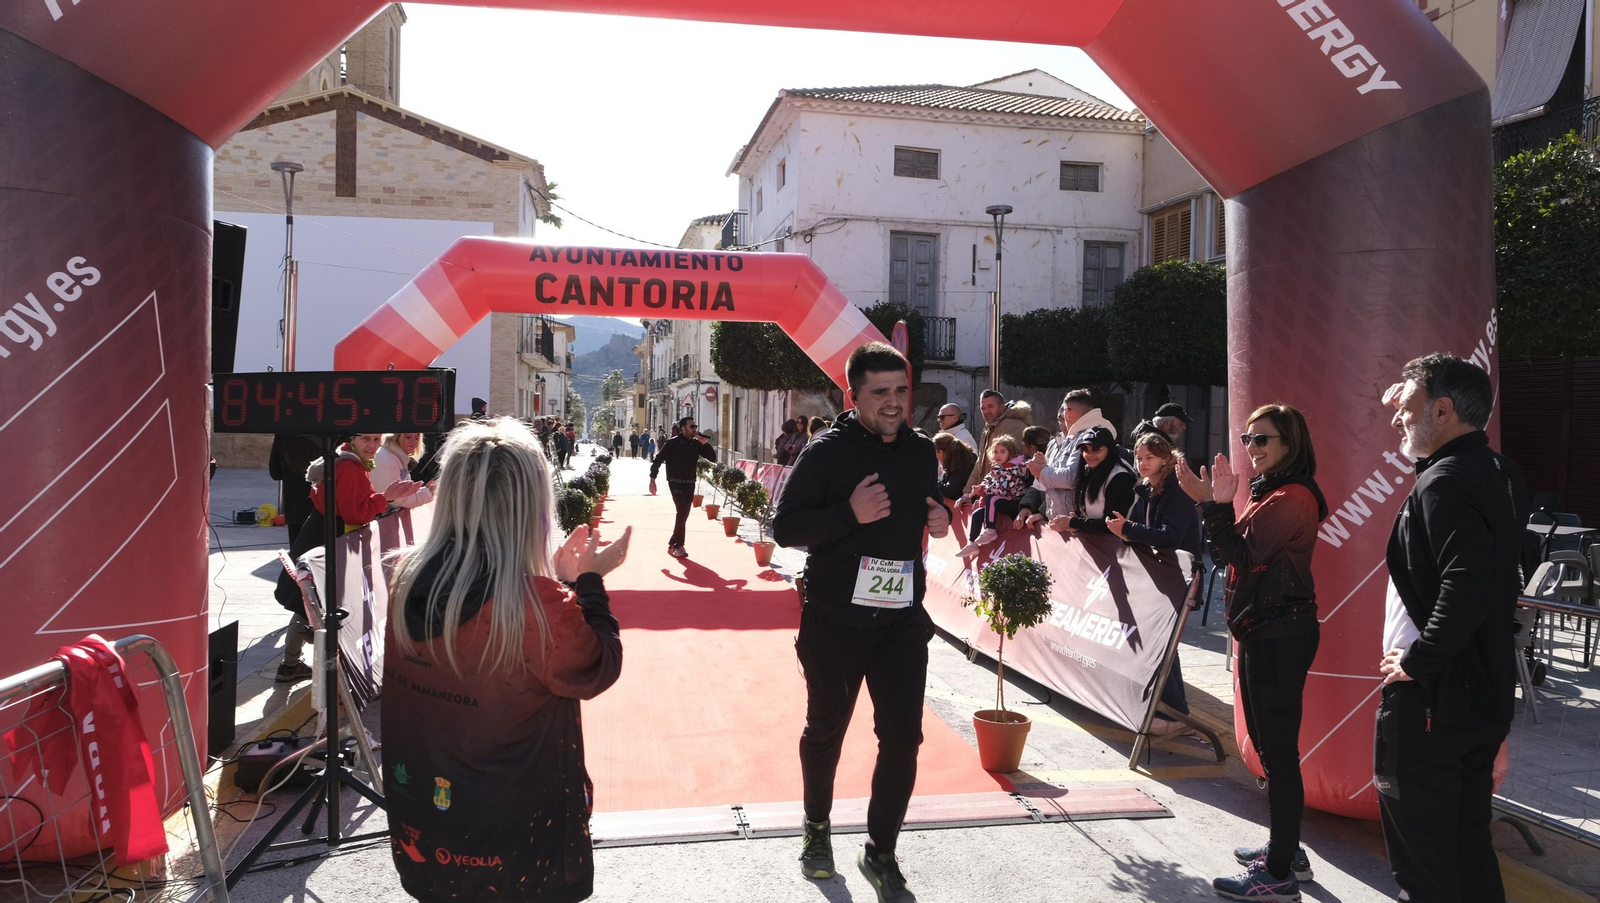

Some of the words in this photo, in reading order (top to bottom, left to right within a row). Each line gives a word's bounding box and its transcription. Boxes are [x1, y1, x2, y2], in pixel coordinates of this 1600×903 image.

[529, 244, 743, 272] AYUNTAMIENTO
[535, 272, 735, 312] CANTORIA
[868, 575, 904, 595] 244
[410, 682, 480, 708] ALMANZORA
[453, 854, 502, 867] VEOLIA
